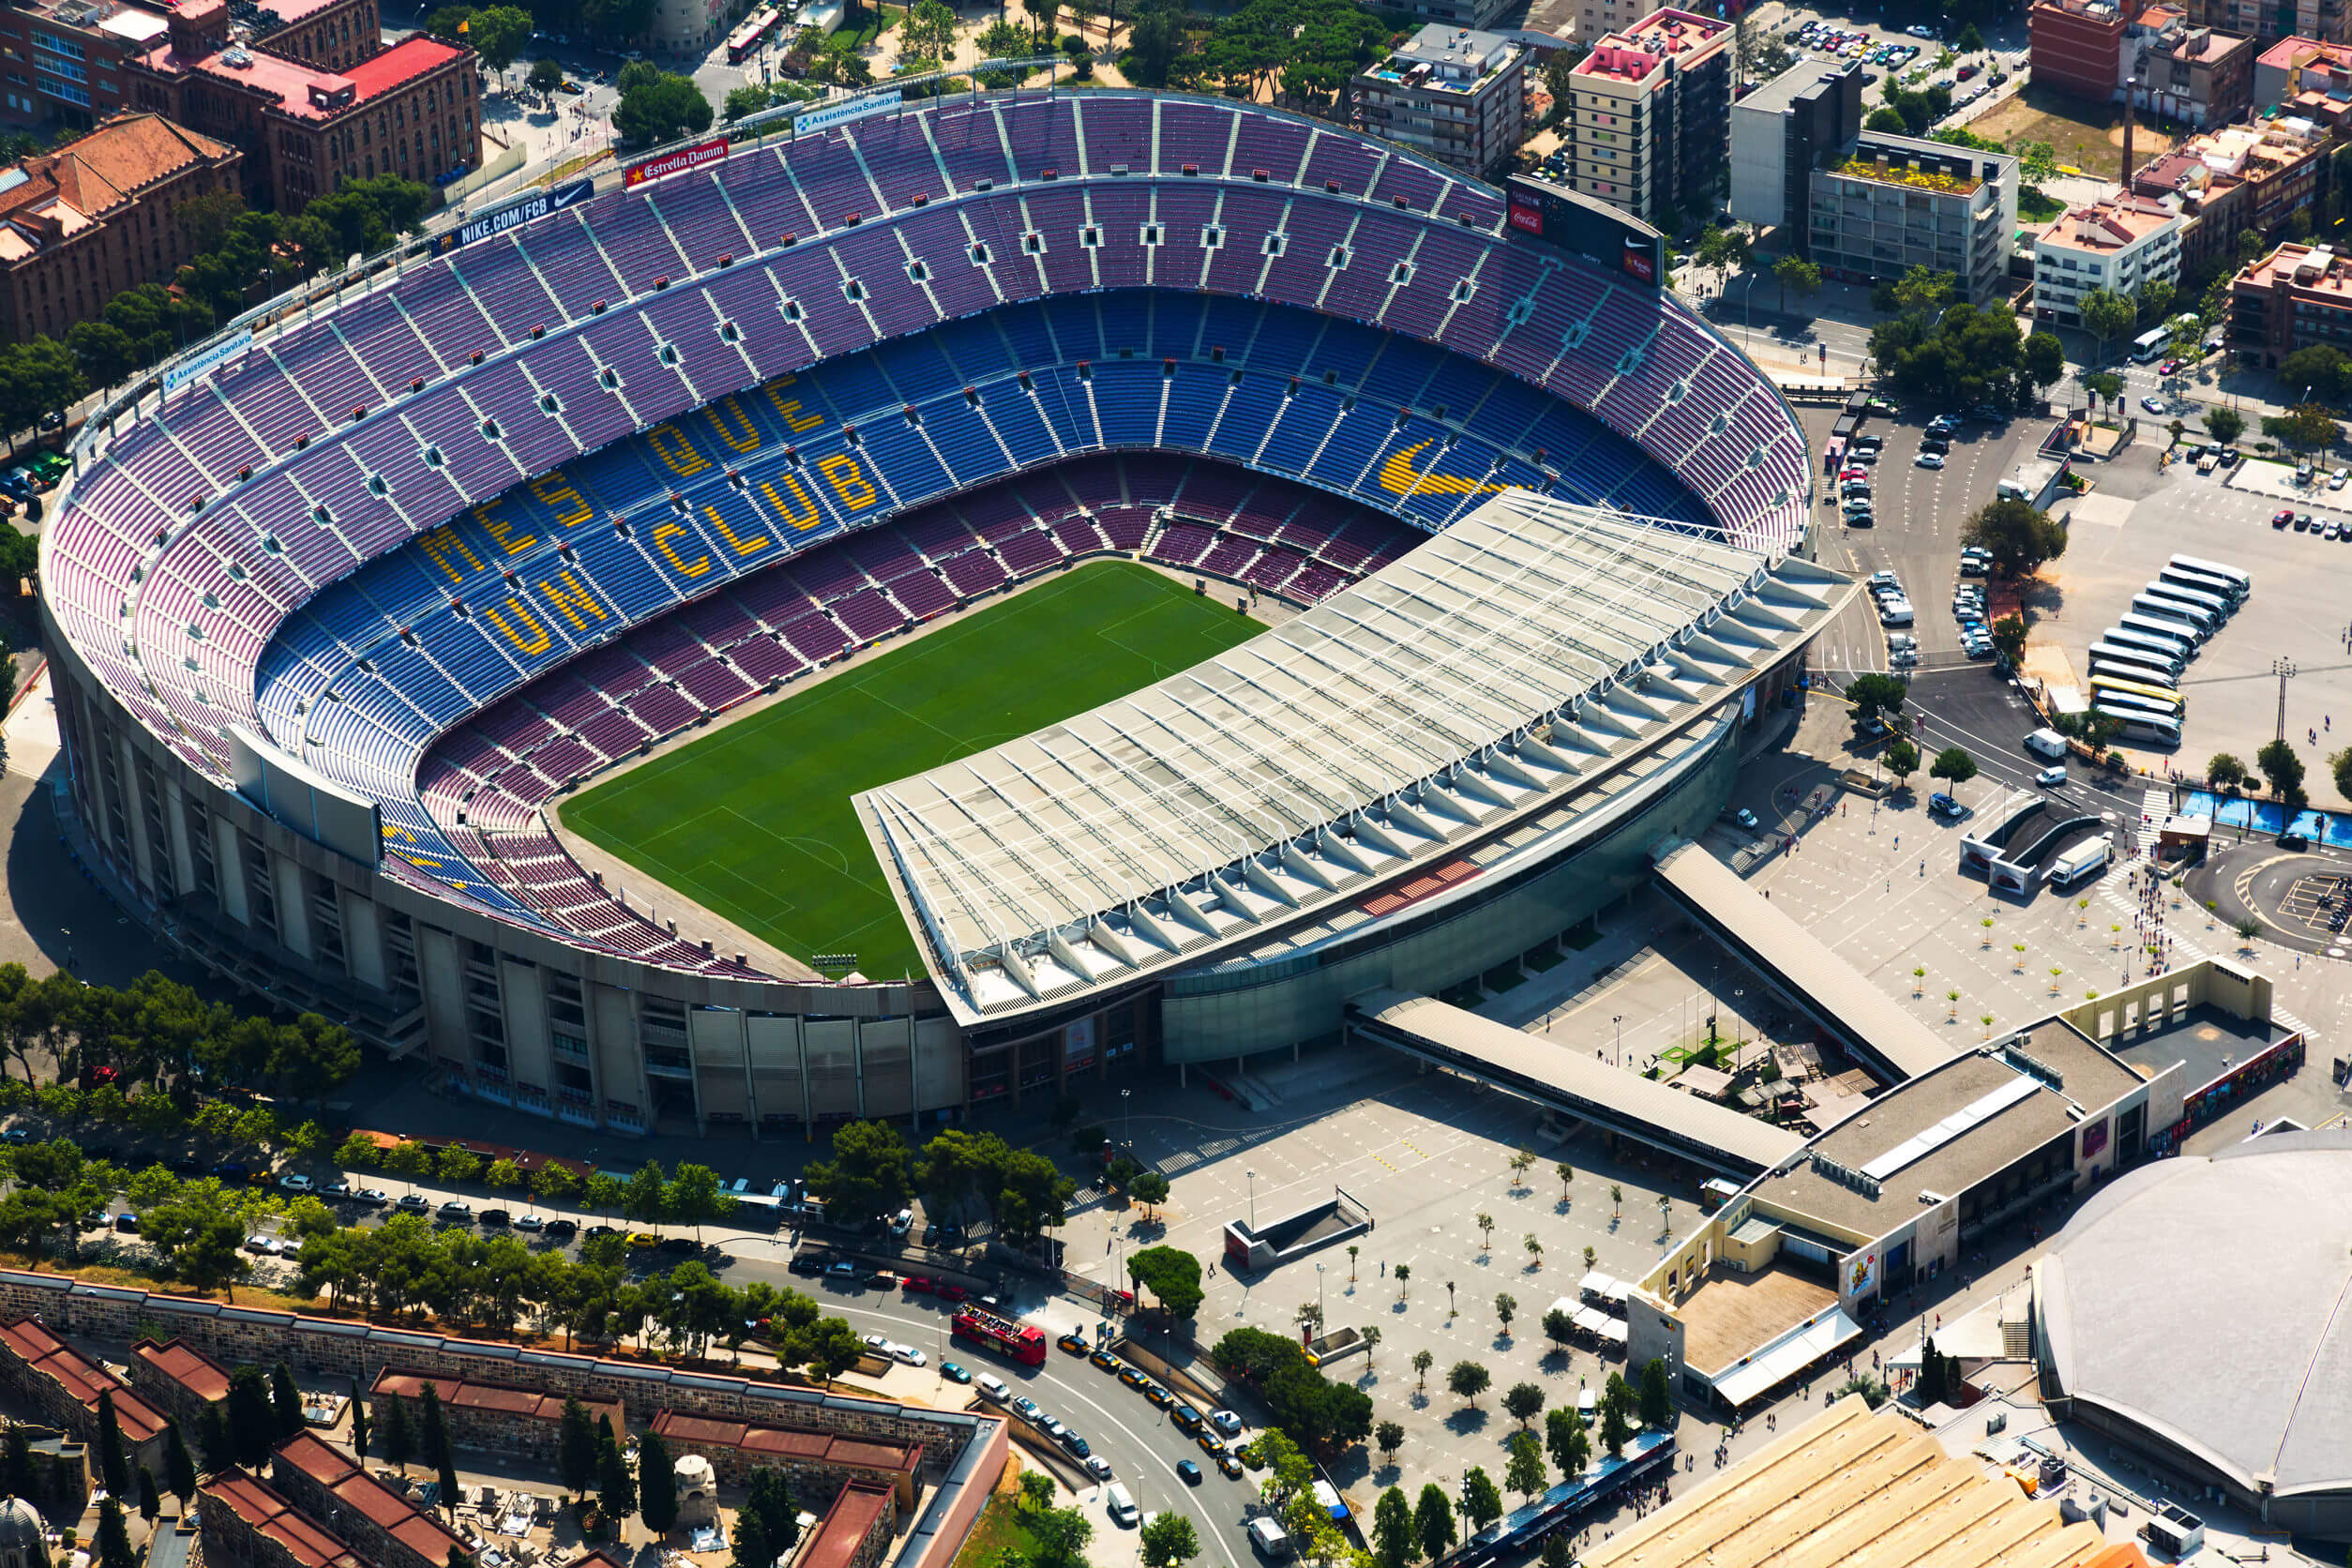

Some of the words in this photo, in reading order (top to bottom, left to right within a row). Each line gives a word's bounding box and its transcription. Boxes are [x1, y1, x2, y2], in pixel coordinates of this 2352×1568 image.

[811, 103, 863, 128] Assistència
[863, 93, 902, 114] Sanitària
[643, 154, 689, 180] Estrella
[687, 143, 725, 165] Damm
[460, 197, 548, 245] NIKE.COM/FCB
[177, 352, 220, 380] Assistència
[219, 334, 252, 358] Sanitària
[647, 373, 825, 478] QUE
[484, 569, 608, 656] UN
[652, 453, 878, 580] CLUB
